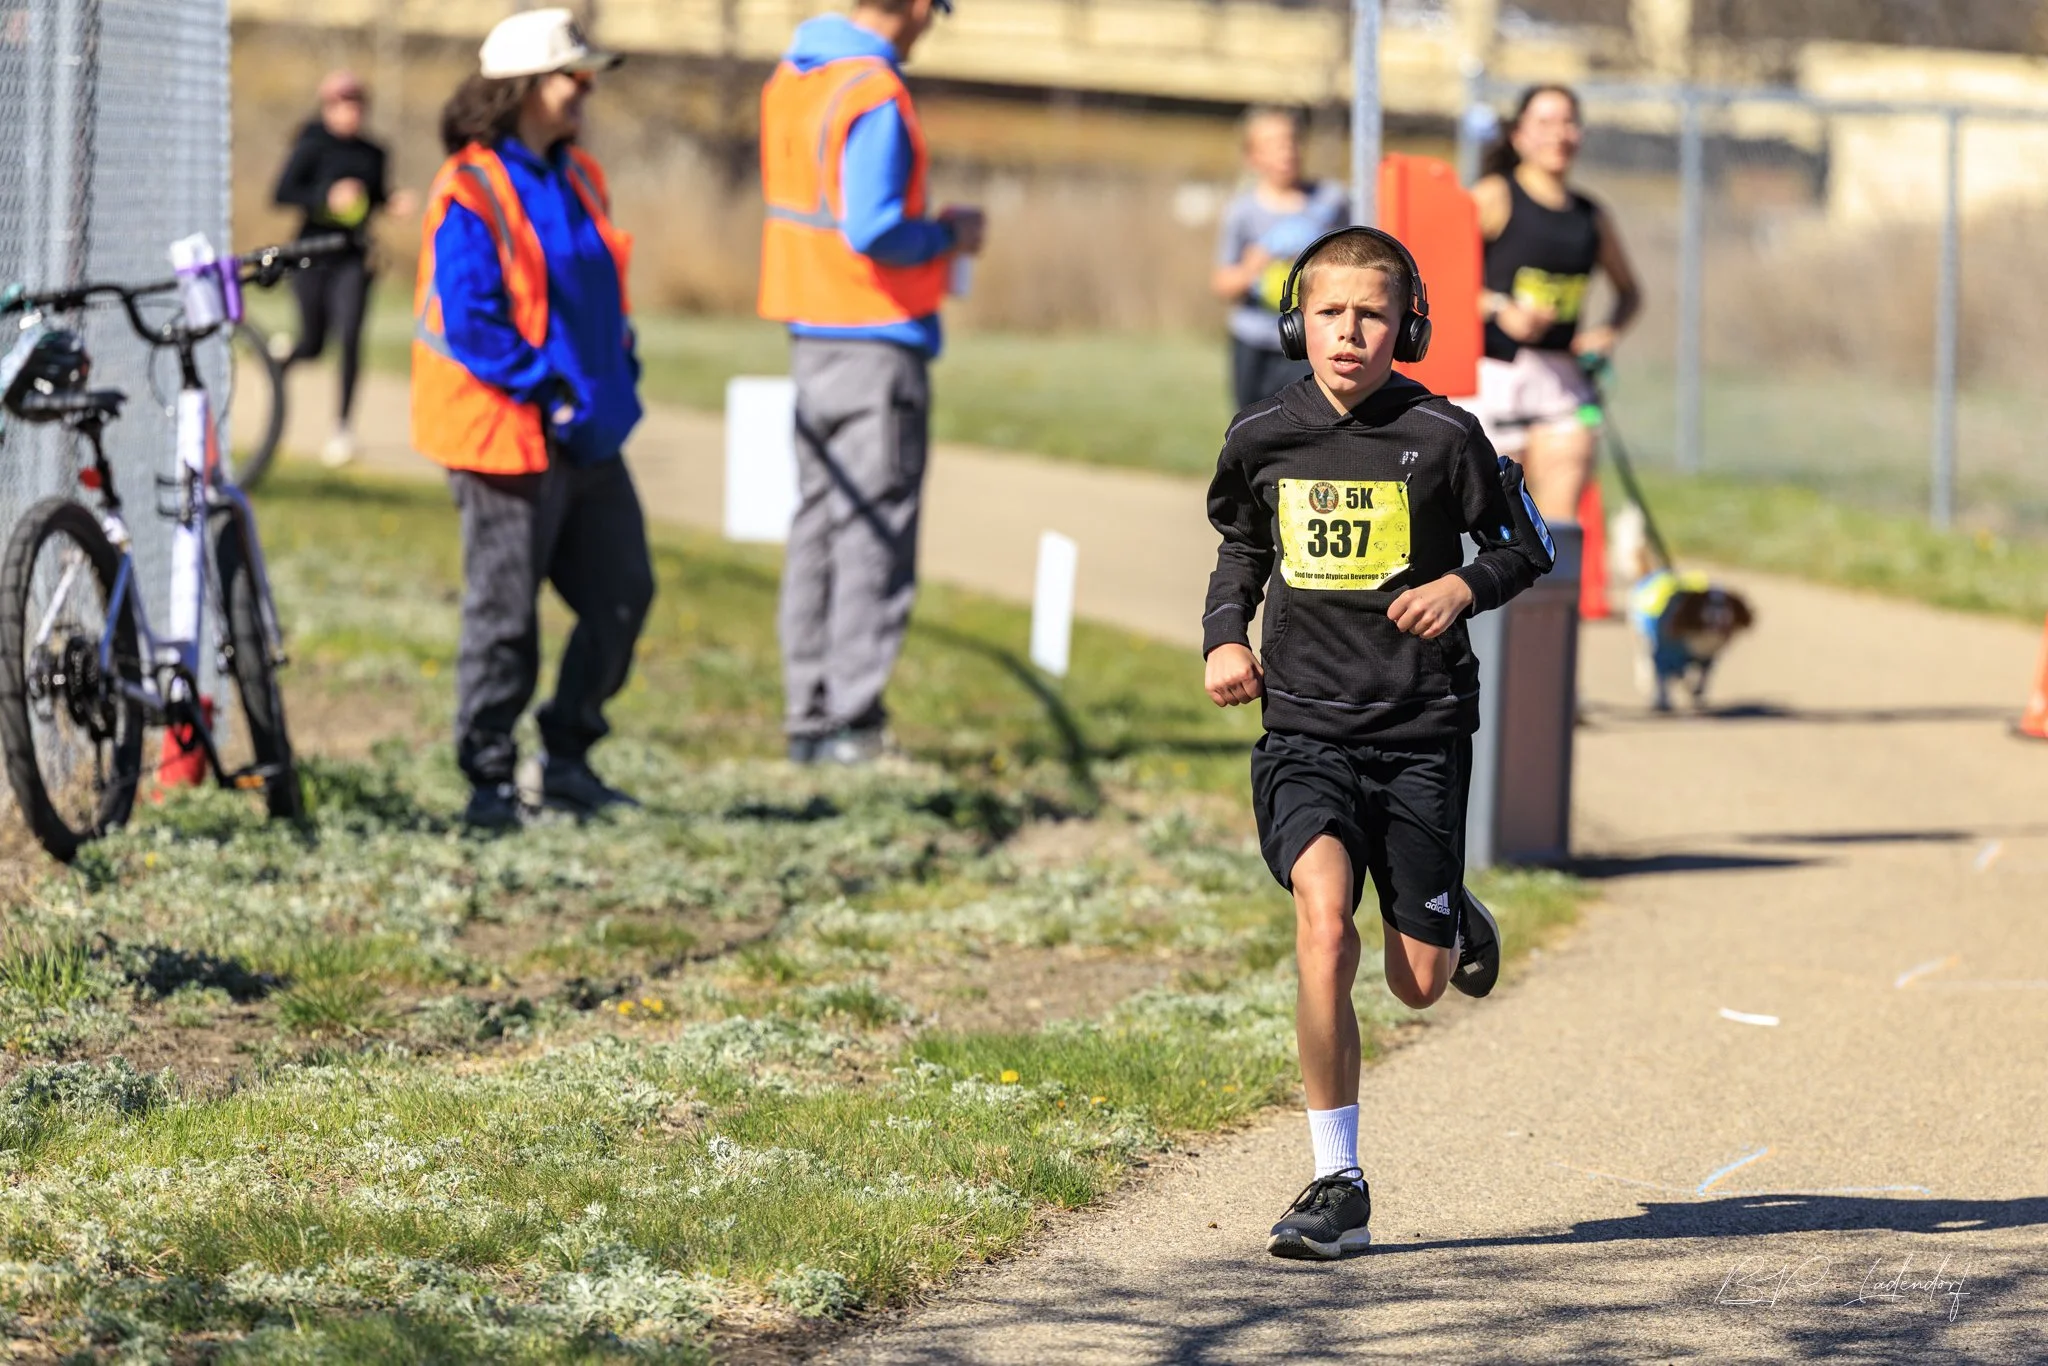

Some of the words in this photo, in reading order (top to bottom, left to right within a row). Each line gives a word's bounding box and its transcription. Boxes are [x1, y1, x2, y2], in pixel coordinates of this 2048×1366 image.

[1346, 488, 1374, 509] 5K
[1308, 519, 1371, 558] 337
[1305, 571, 1314, 579] for
[1351, 572, 1379, 580] Beverage
[1425, 901, 1451, 915] adidas
